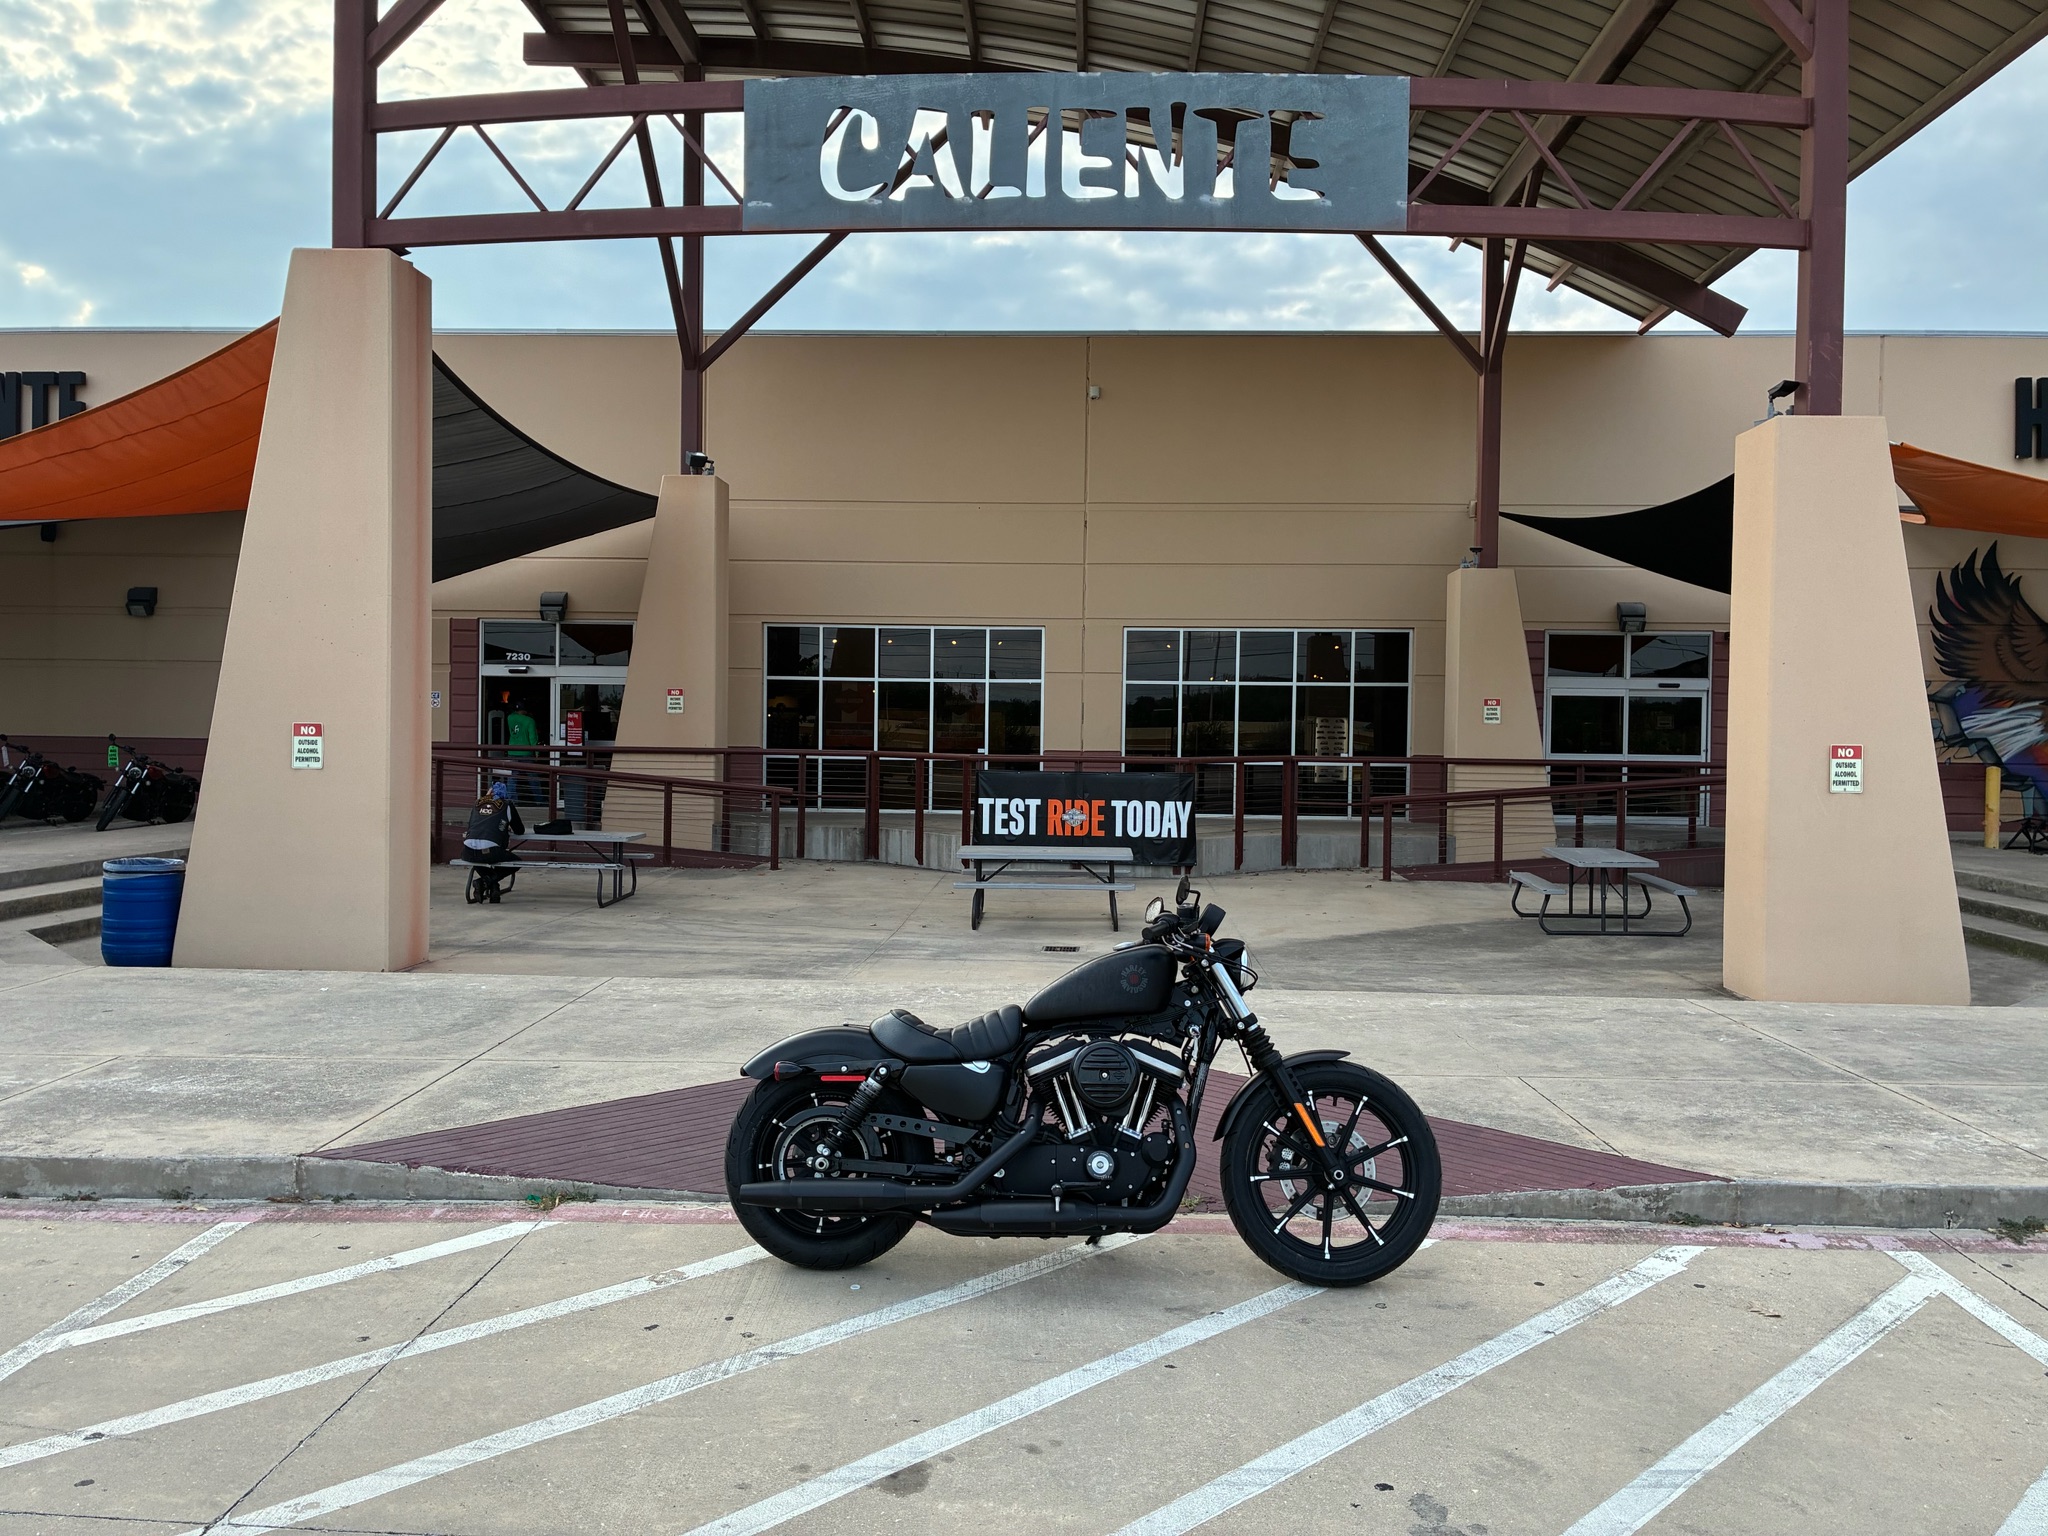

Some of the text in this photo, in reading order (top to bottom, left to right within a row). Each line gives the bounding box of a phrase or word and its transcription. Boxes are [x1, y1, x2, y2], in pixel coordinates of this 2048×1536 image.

[820, 102, 1326, 201] CALIENTE
[505, 652, 531, 661] 7230
[300, 725, 317, 735] NO
[1837, 748, 1854, 758] NO
[978, 797, 1193, 839] TEST RIDE TODAY
